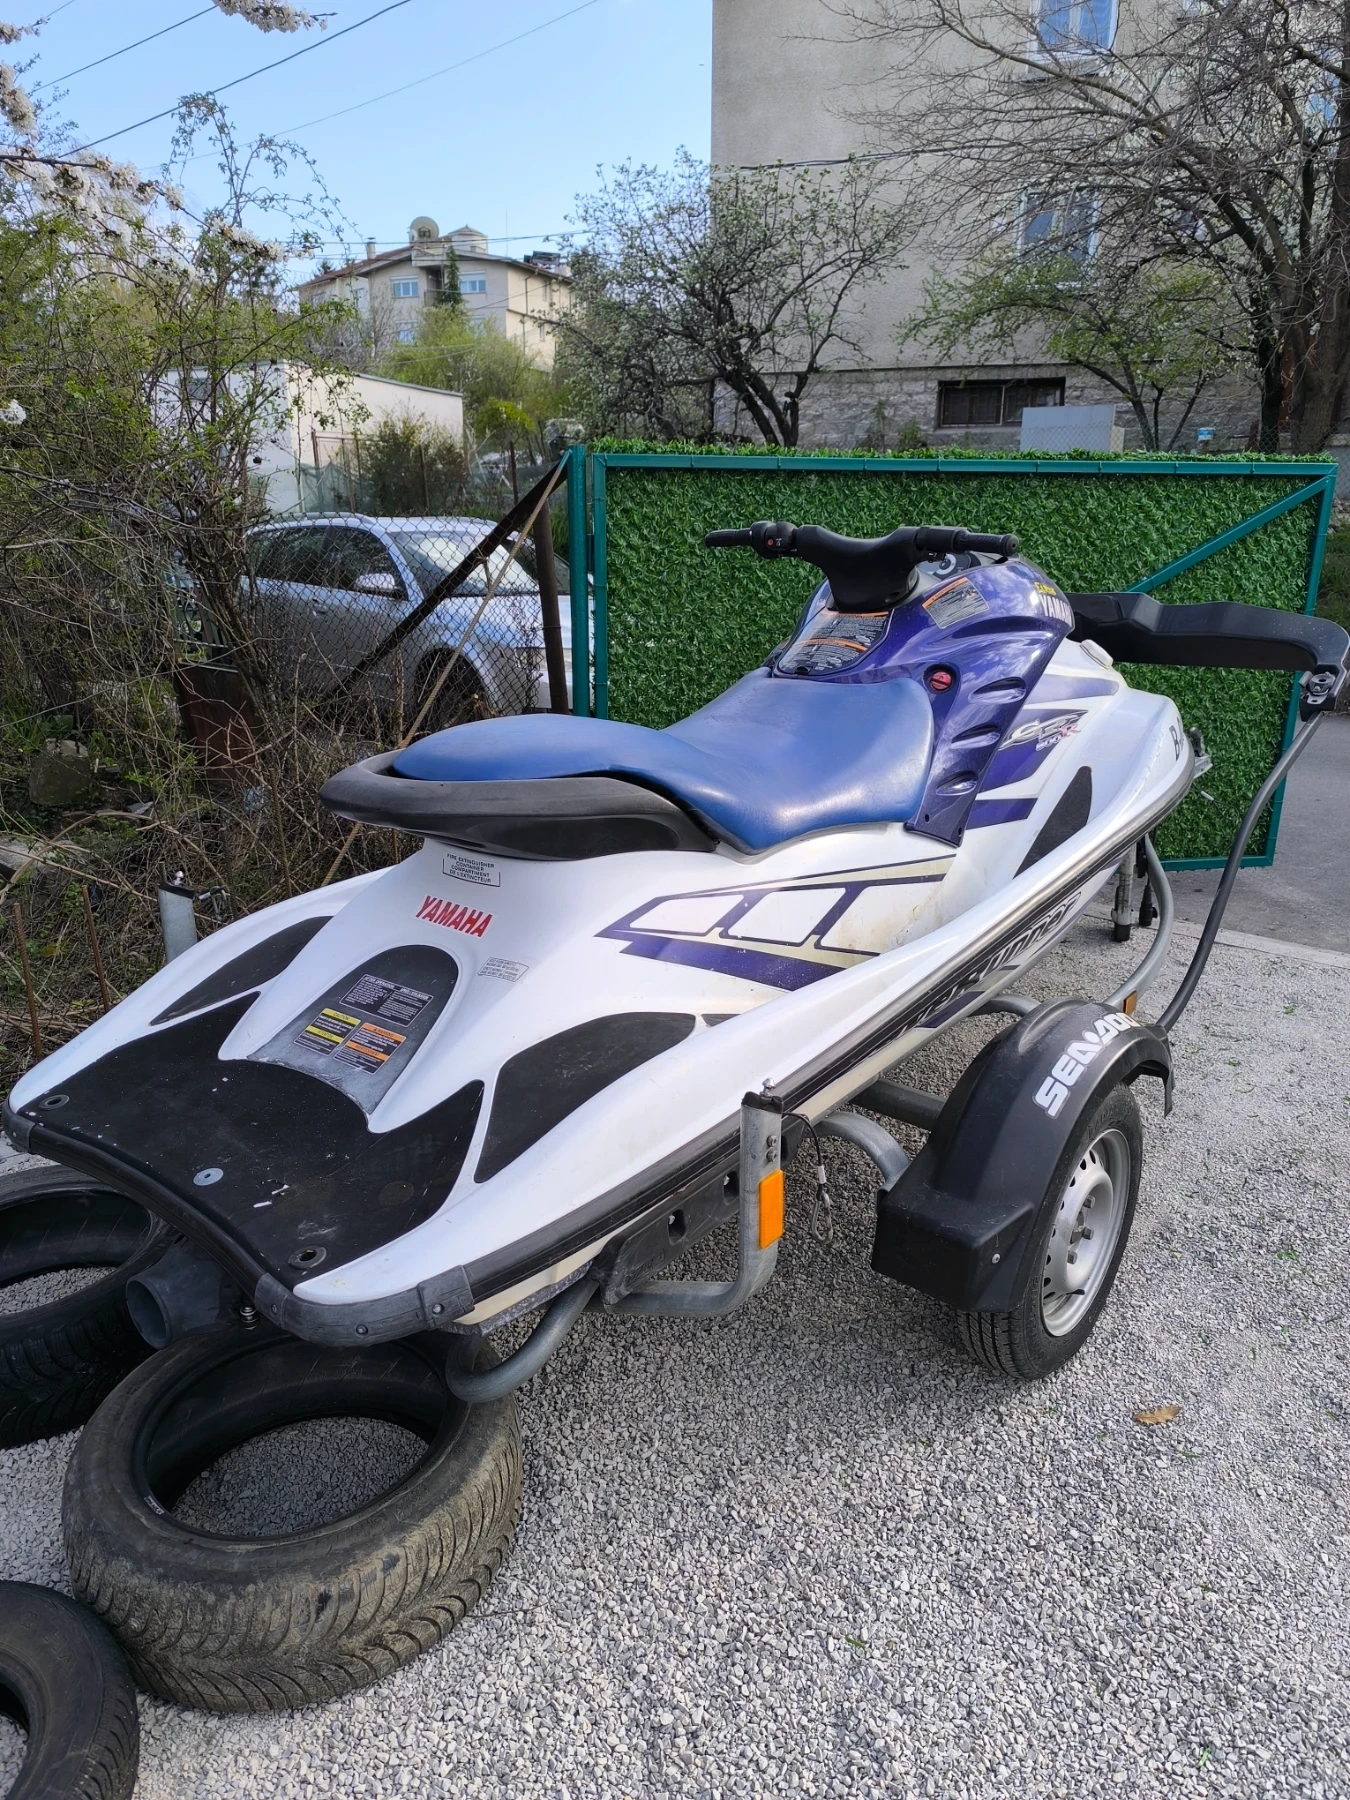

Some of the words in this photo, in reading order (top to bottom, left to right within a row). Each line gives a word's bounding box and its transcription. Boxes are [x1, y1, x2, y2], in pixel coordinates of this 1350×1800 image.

[446, 853, 457, 861] FIRE
[458, 856, 495, 868] EXTINGUISHER
[455, 861, 485, 871] CONTAINER
[415, 895, 493, 937] YAMAHA
